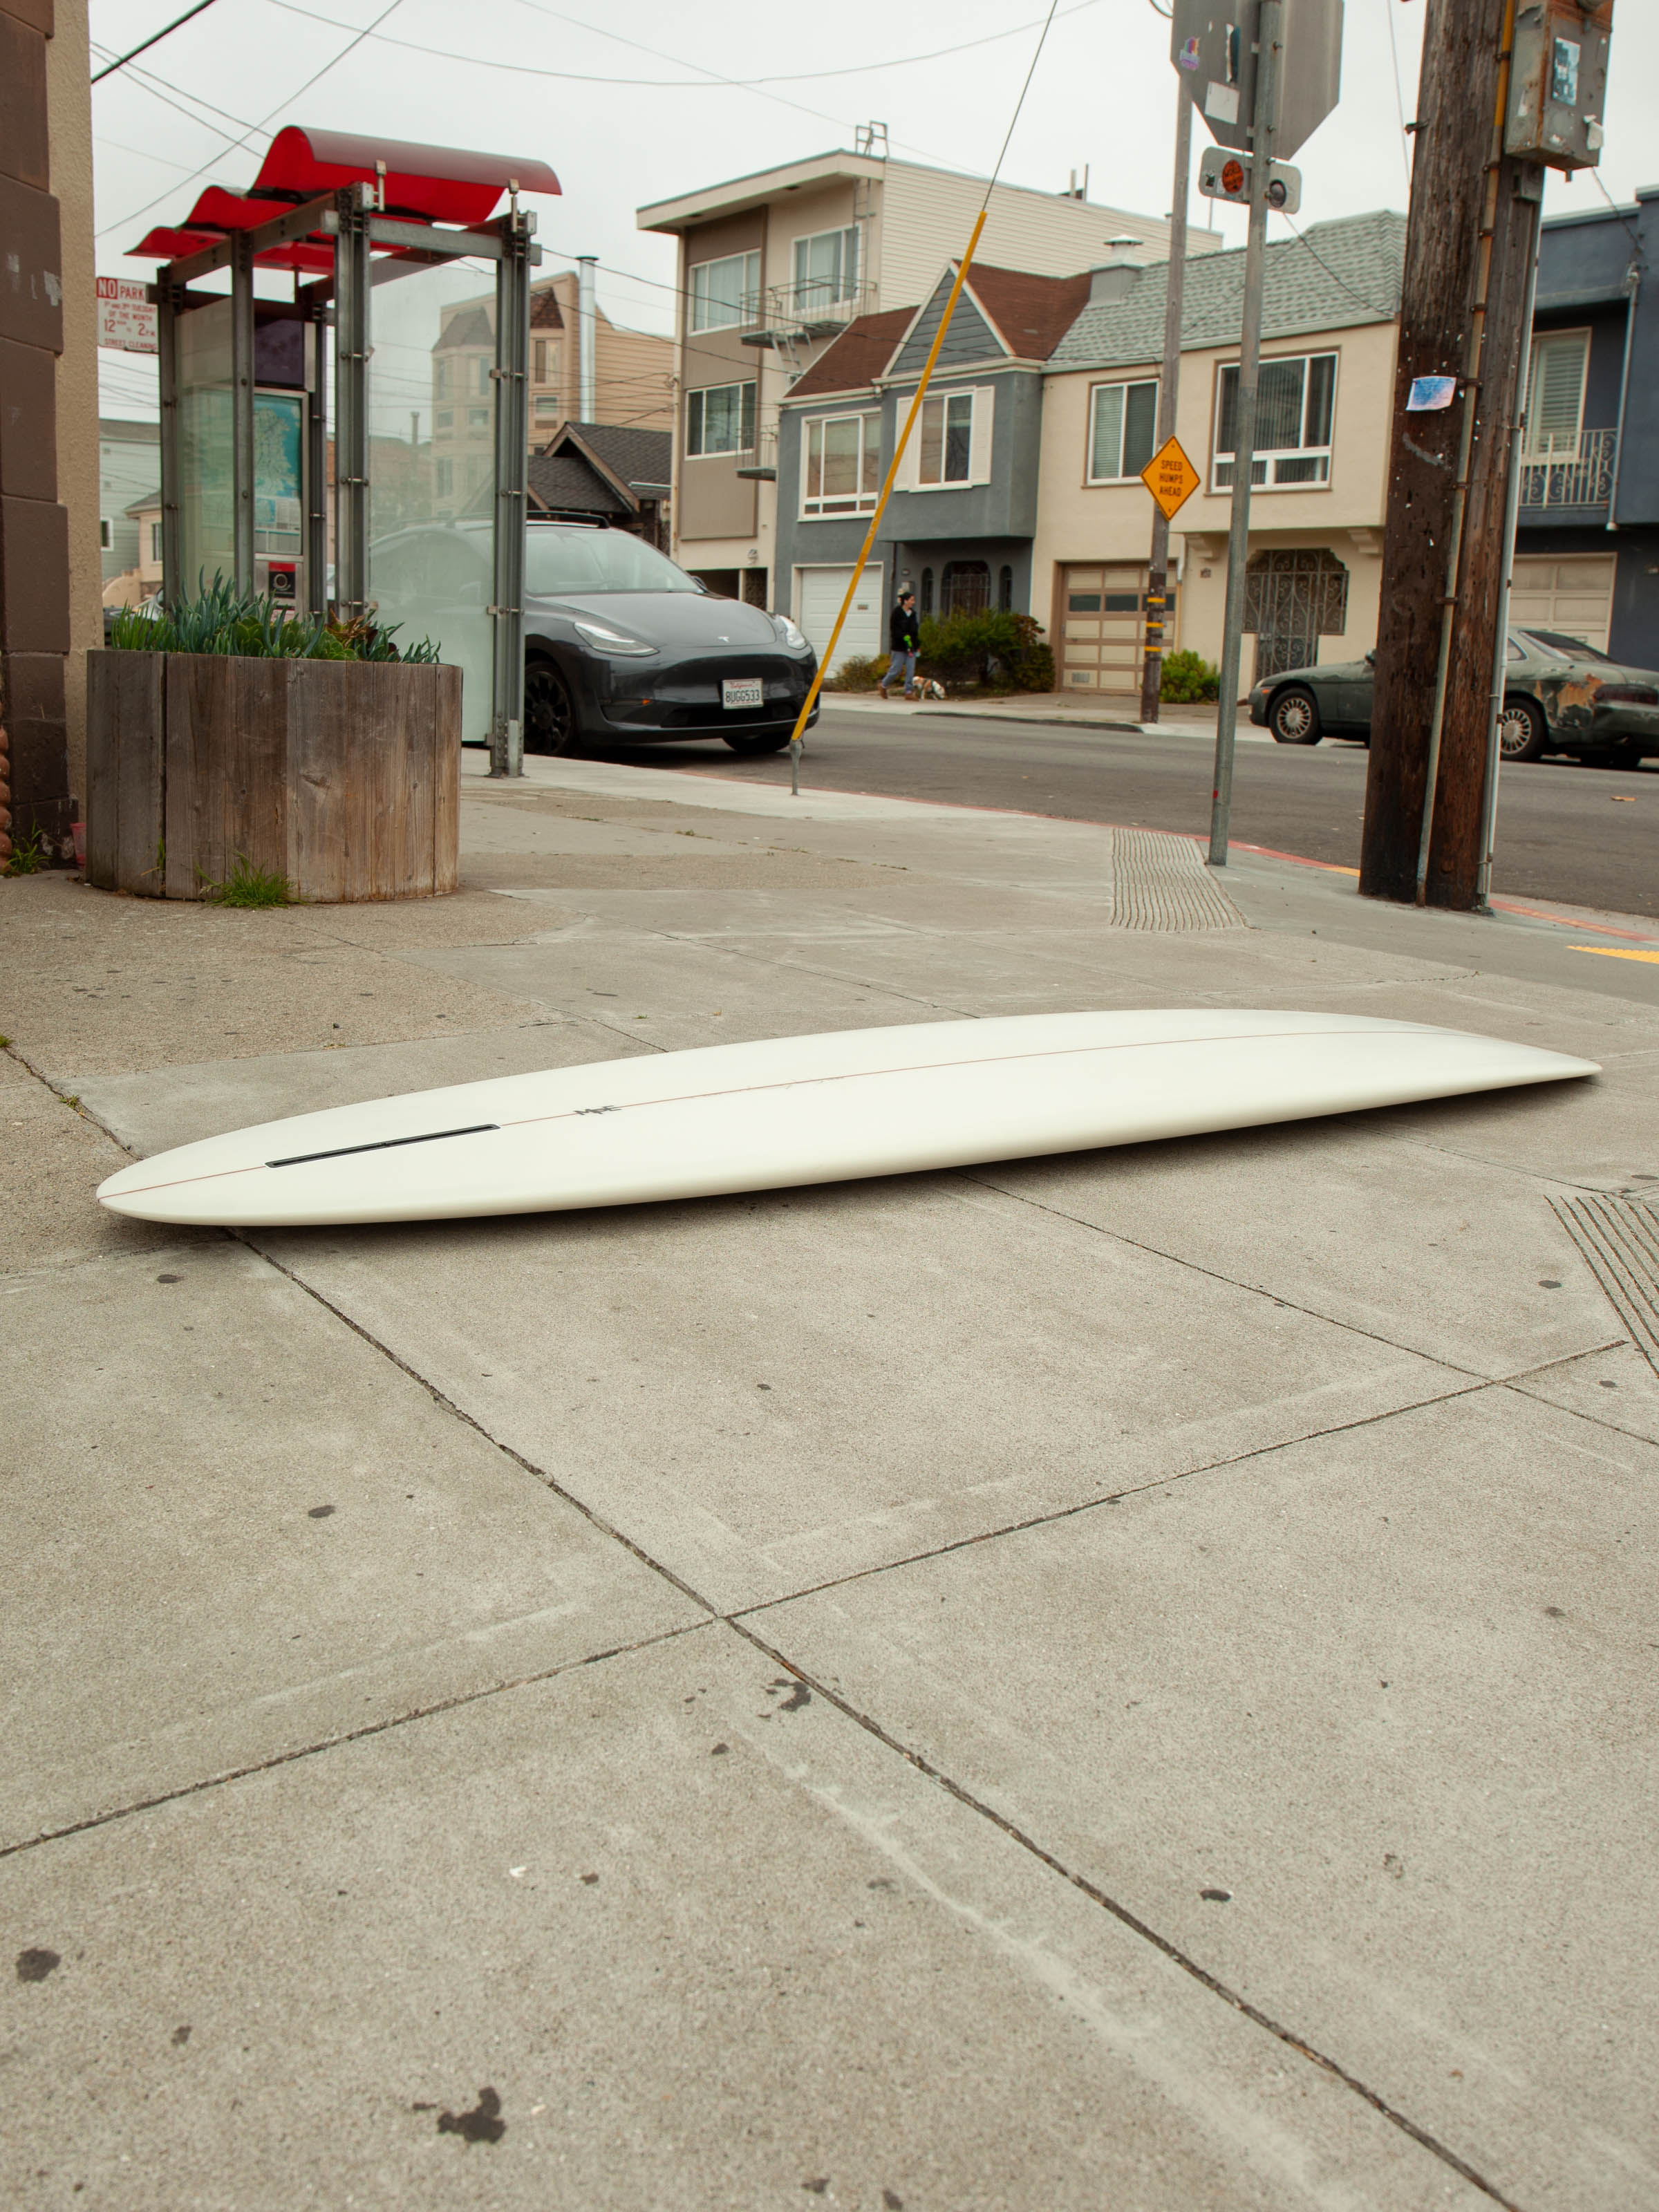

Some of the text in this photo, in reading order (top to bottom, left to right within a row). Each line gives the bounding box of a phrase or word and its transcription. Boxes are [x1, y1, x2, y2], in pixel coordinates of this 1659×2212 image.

[98, 279, 144, 299] NO PARK
[104, 319, 115, 332] 12
[1161, 459, 1183, 471] SPEED
[1159, 472, 1183, 485] HUMPS
[1159, 485, 1181, 497] AHEAD
